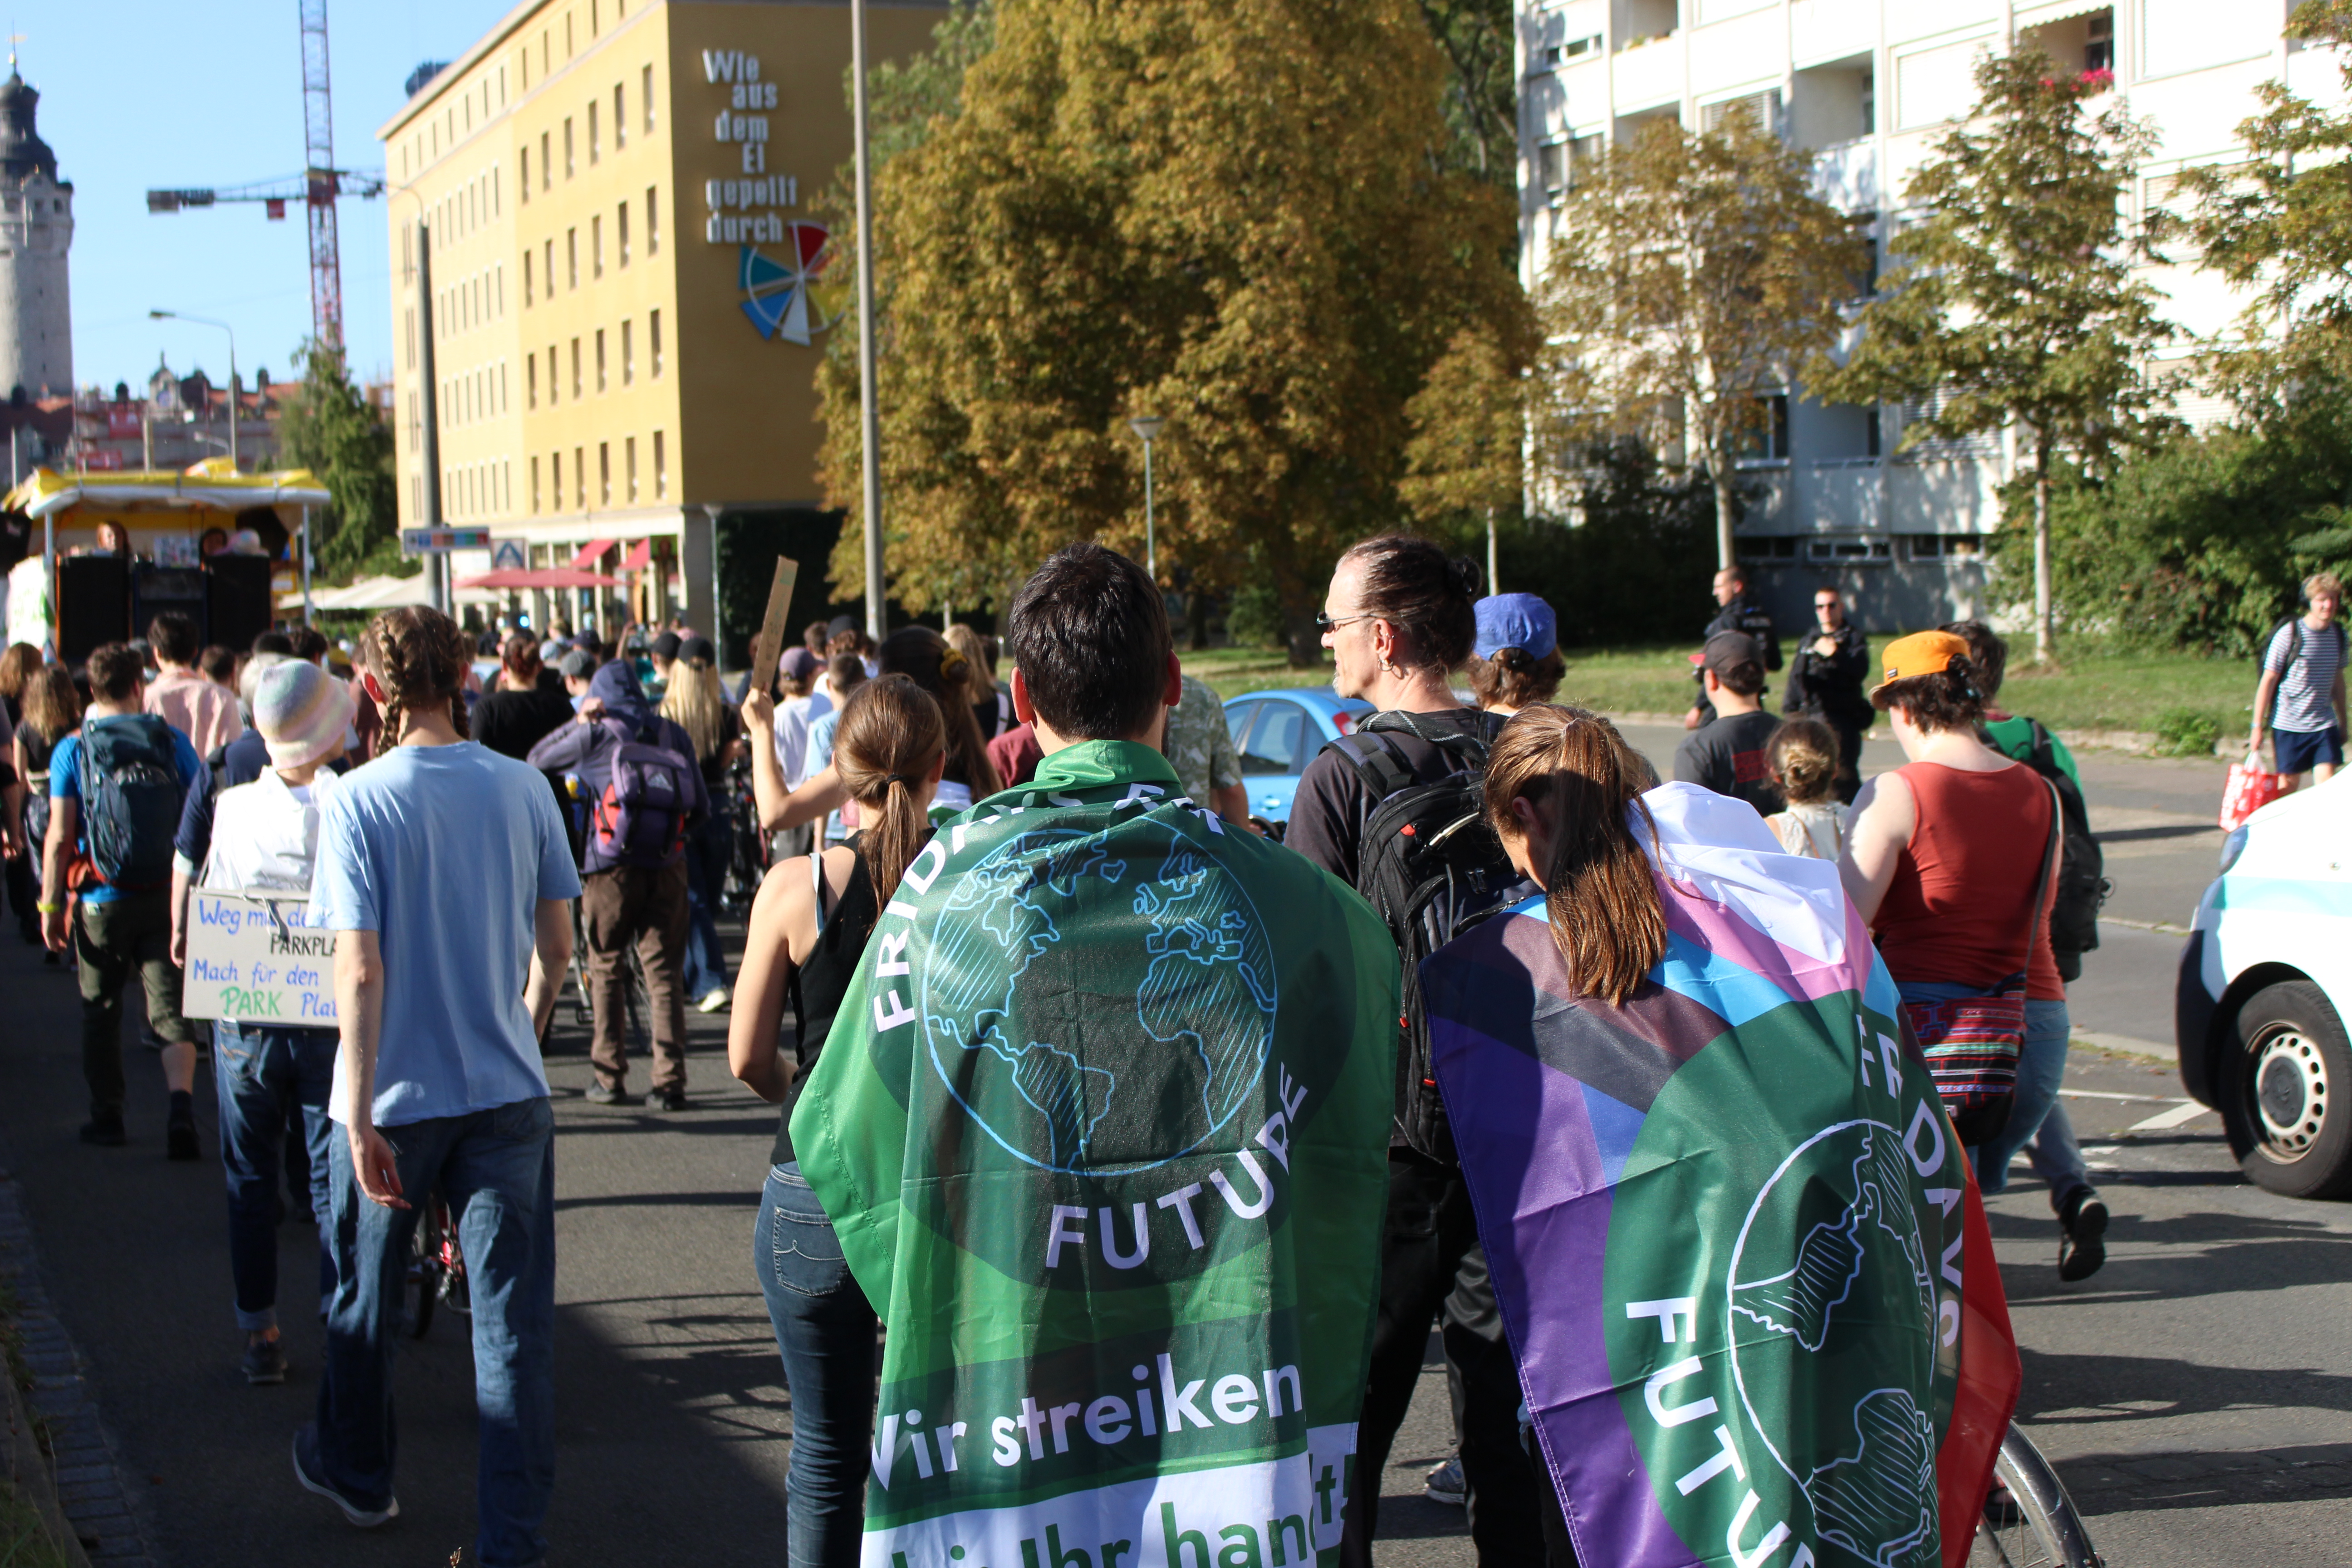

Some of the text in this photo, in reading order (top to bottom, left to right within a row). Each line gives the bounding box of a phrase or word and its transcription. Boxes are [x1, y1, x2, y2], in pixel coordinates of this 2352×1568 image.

[732, 82, 778, 110] aus
[715, 109, 769, 142] dem
[706, 175, 797, 211] gepellt
[706, 211, 783, 244] durch
[199, 898, 241, 935] Weg
[270, 933, 337, 956] PARKPLA
[194, 959, 319, 989] Mach für den
[220, 986, 283, 1016] PARK
[1045, 1061, 1308, 1269] FUTURE
[991, 1352, 1303, 1468] streiken
